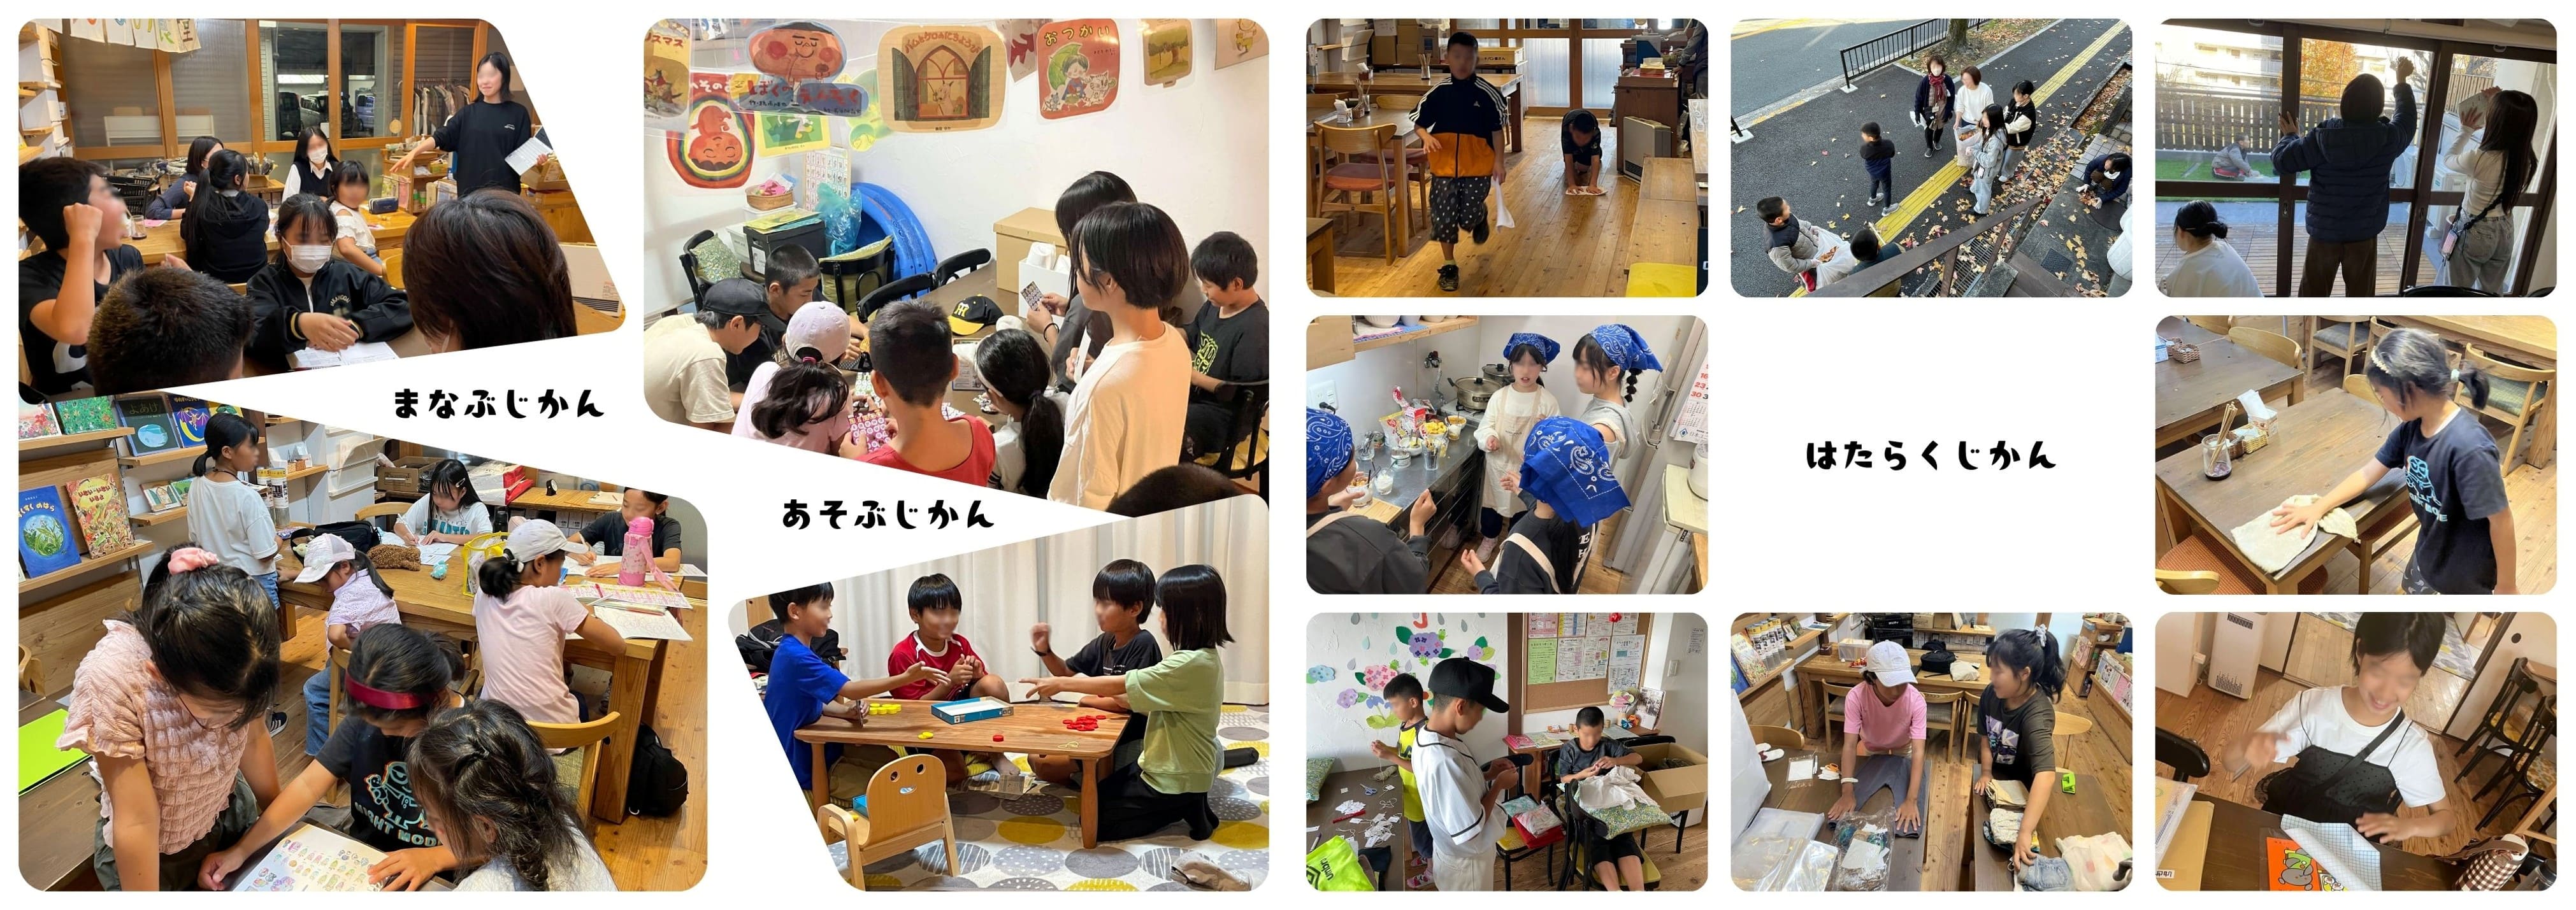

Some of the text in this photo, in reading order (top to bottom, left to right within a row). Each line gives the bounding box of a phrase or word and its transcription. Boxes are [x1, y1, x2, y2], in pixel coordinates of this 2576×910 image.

[1044, 24, 1110, 46] おつかい
[129, 402, 158, 415] よあけ
[36, 502, 55, 512] のはら
[354, 801, 443, 847] NIGHT MOD
